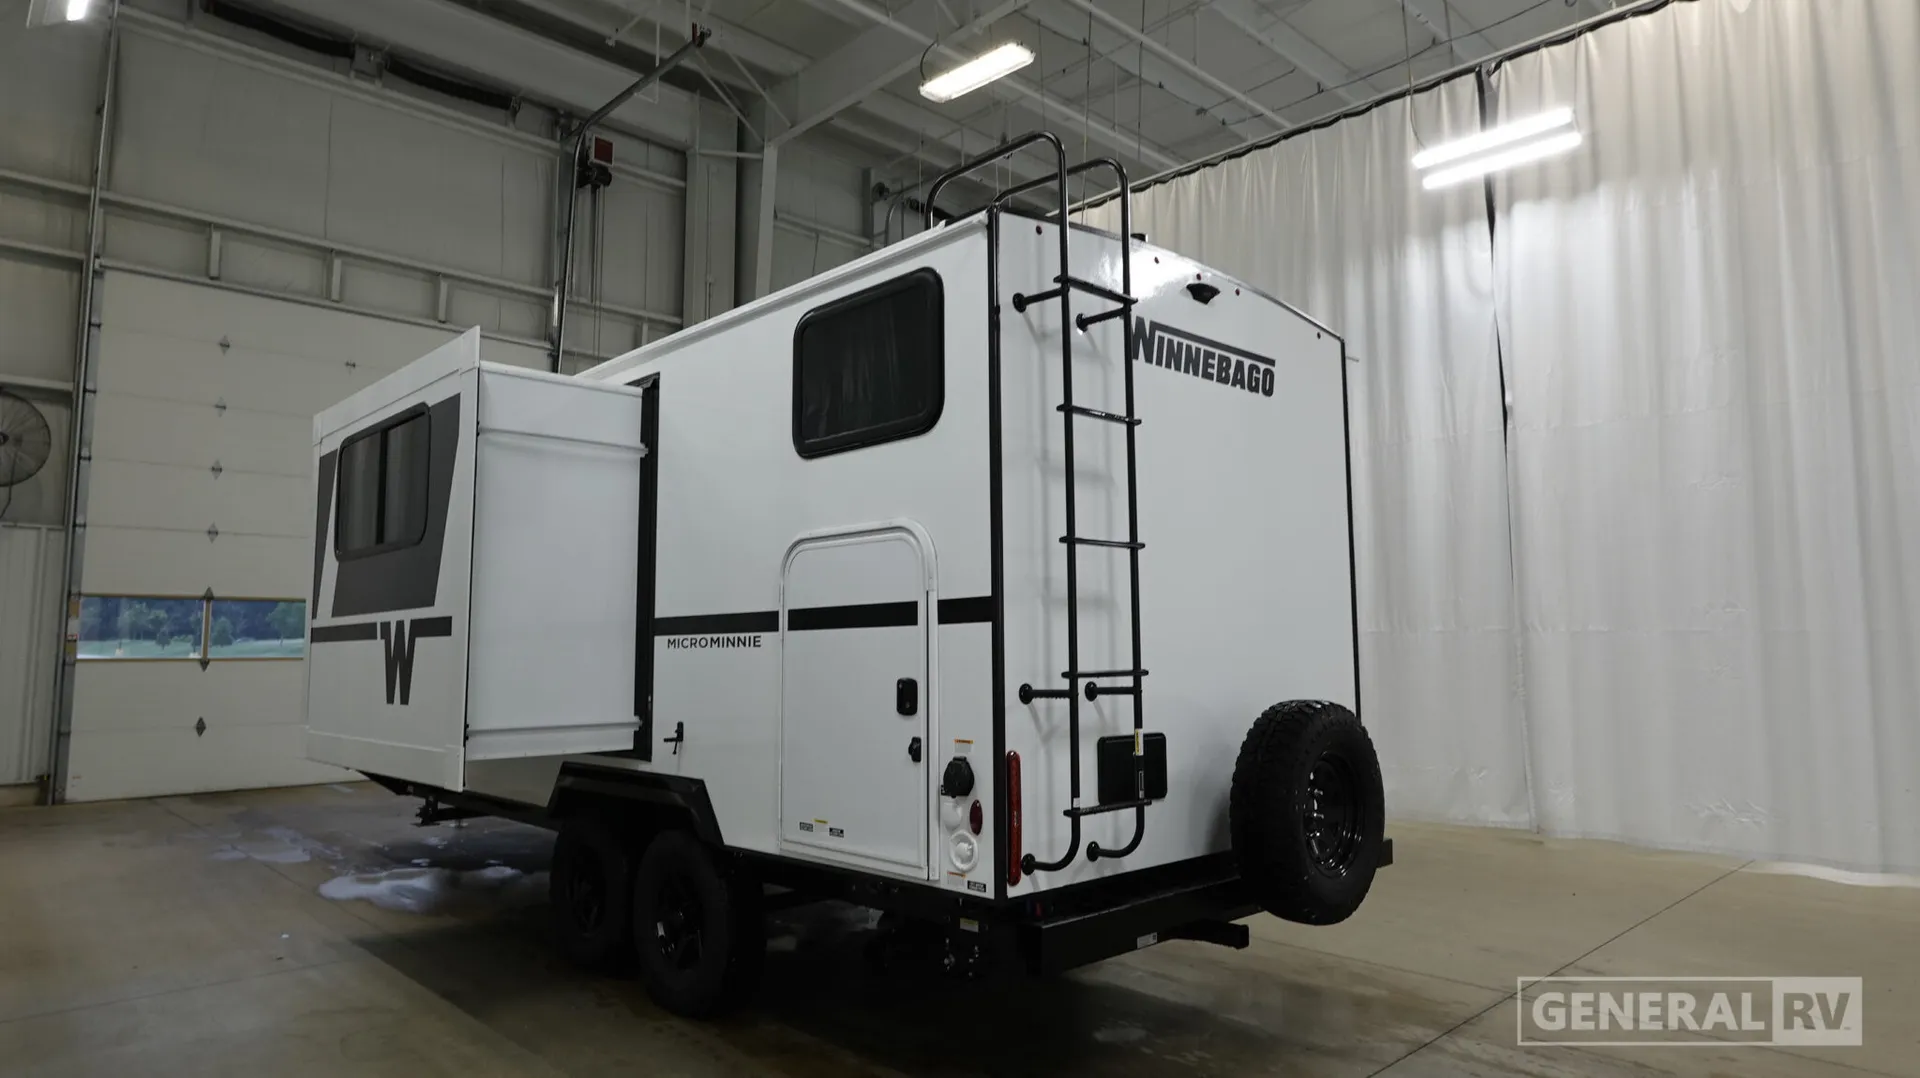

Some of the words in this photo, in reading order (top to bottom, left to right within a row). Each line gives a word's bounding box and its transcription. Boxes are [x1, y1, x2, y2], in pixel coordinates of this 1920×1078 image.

[1131, 315, 1276, 397] WINNEBAGO
[380, 618, 418, 706] W
[667, 635, 762, 649] MICROMINNIE
